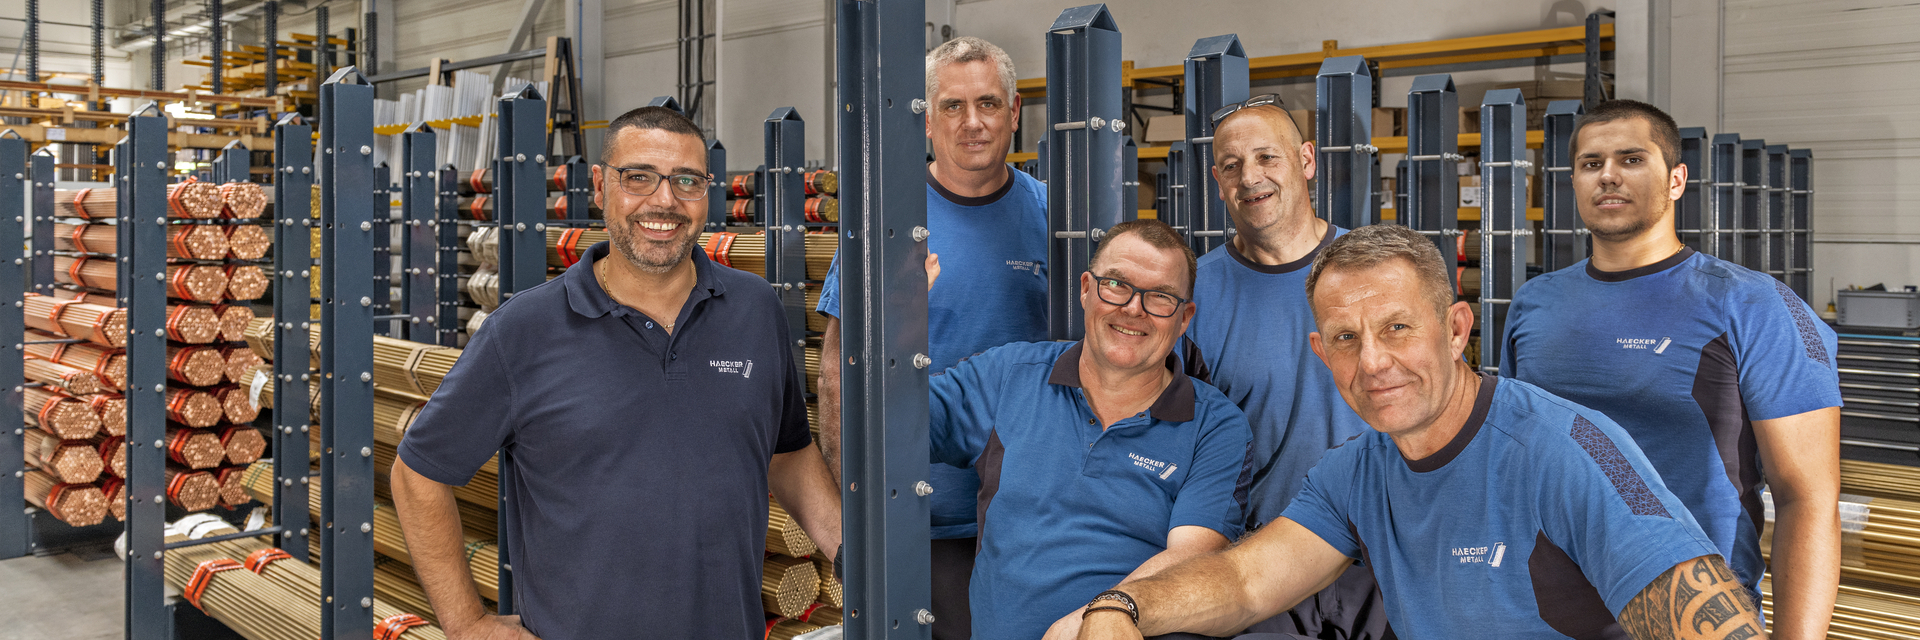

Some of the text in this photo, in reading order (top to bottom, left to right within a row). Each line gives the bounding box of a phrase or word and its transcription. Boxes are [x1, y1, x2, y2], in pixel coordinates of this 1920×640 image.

[709, 360, 744, 368] HAECKER
[1128, 452, 1165, 468] HAECKER
[1133, 460, 1156, 472] METALL
[1451, 546, 1488, 556] HAECKER
